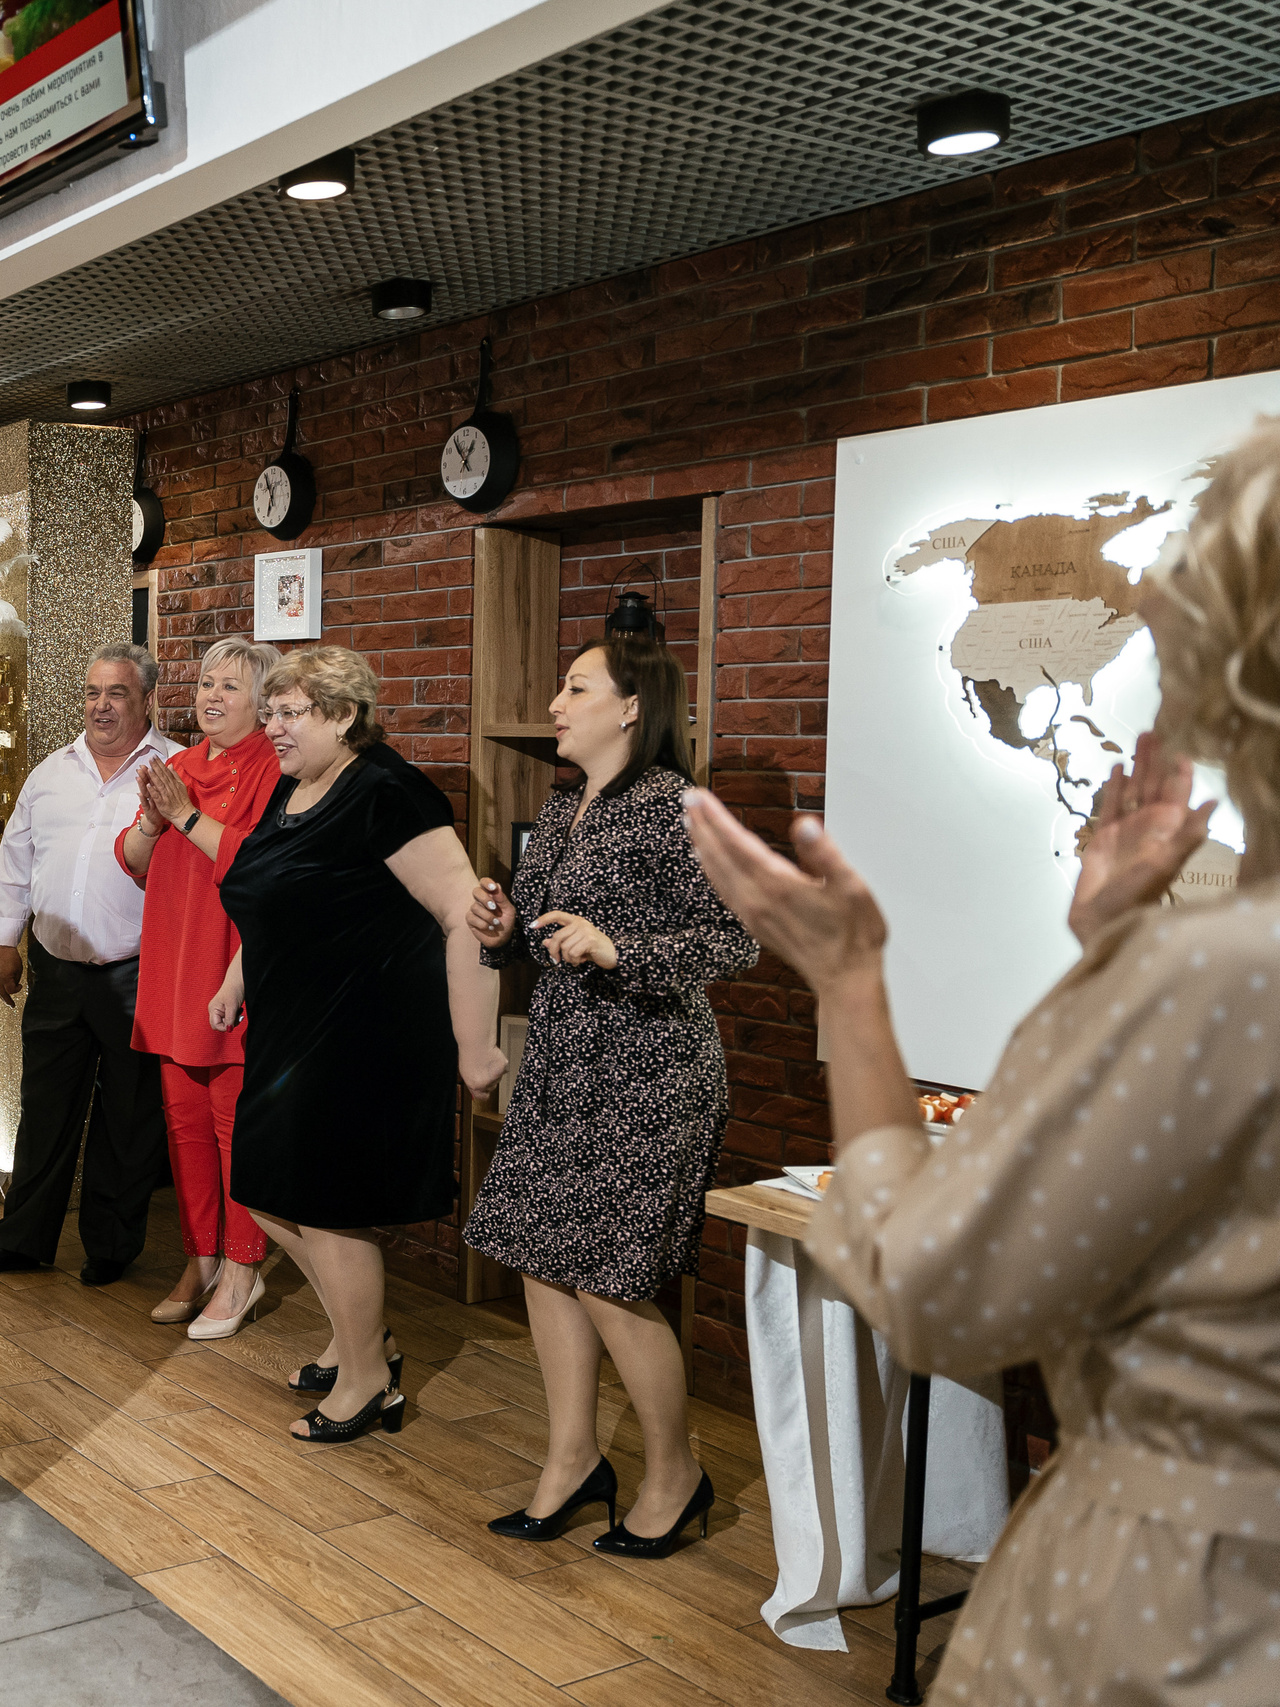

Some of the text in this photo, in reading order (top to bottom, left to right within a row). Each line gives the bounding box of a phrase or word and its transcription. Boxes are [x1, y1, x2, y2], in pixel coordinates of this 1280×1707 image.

[0, 102, 20, 121] очень
[21, 87, 45, 109] любим
[47, 55, 96, 93] мероприятия
[98, 50, 104, 62] в
[4, 126, 19, 142] нам
[20, 93, 73, 132] познакомиться
[74, 90, 79, 101] с
[80, 77, 101, 97] вами
[30, 129, 52, 151] время
[463, 429, 470, 437] 12
[446, 447, 452, 455] 10
[932, 536, 966, 550] США
[1010, 561, 1077, 579] КАНАДА
[1019, 637, 1052, 650] США
[1174, 871, 1233, 887] АЗИЛИ
